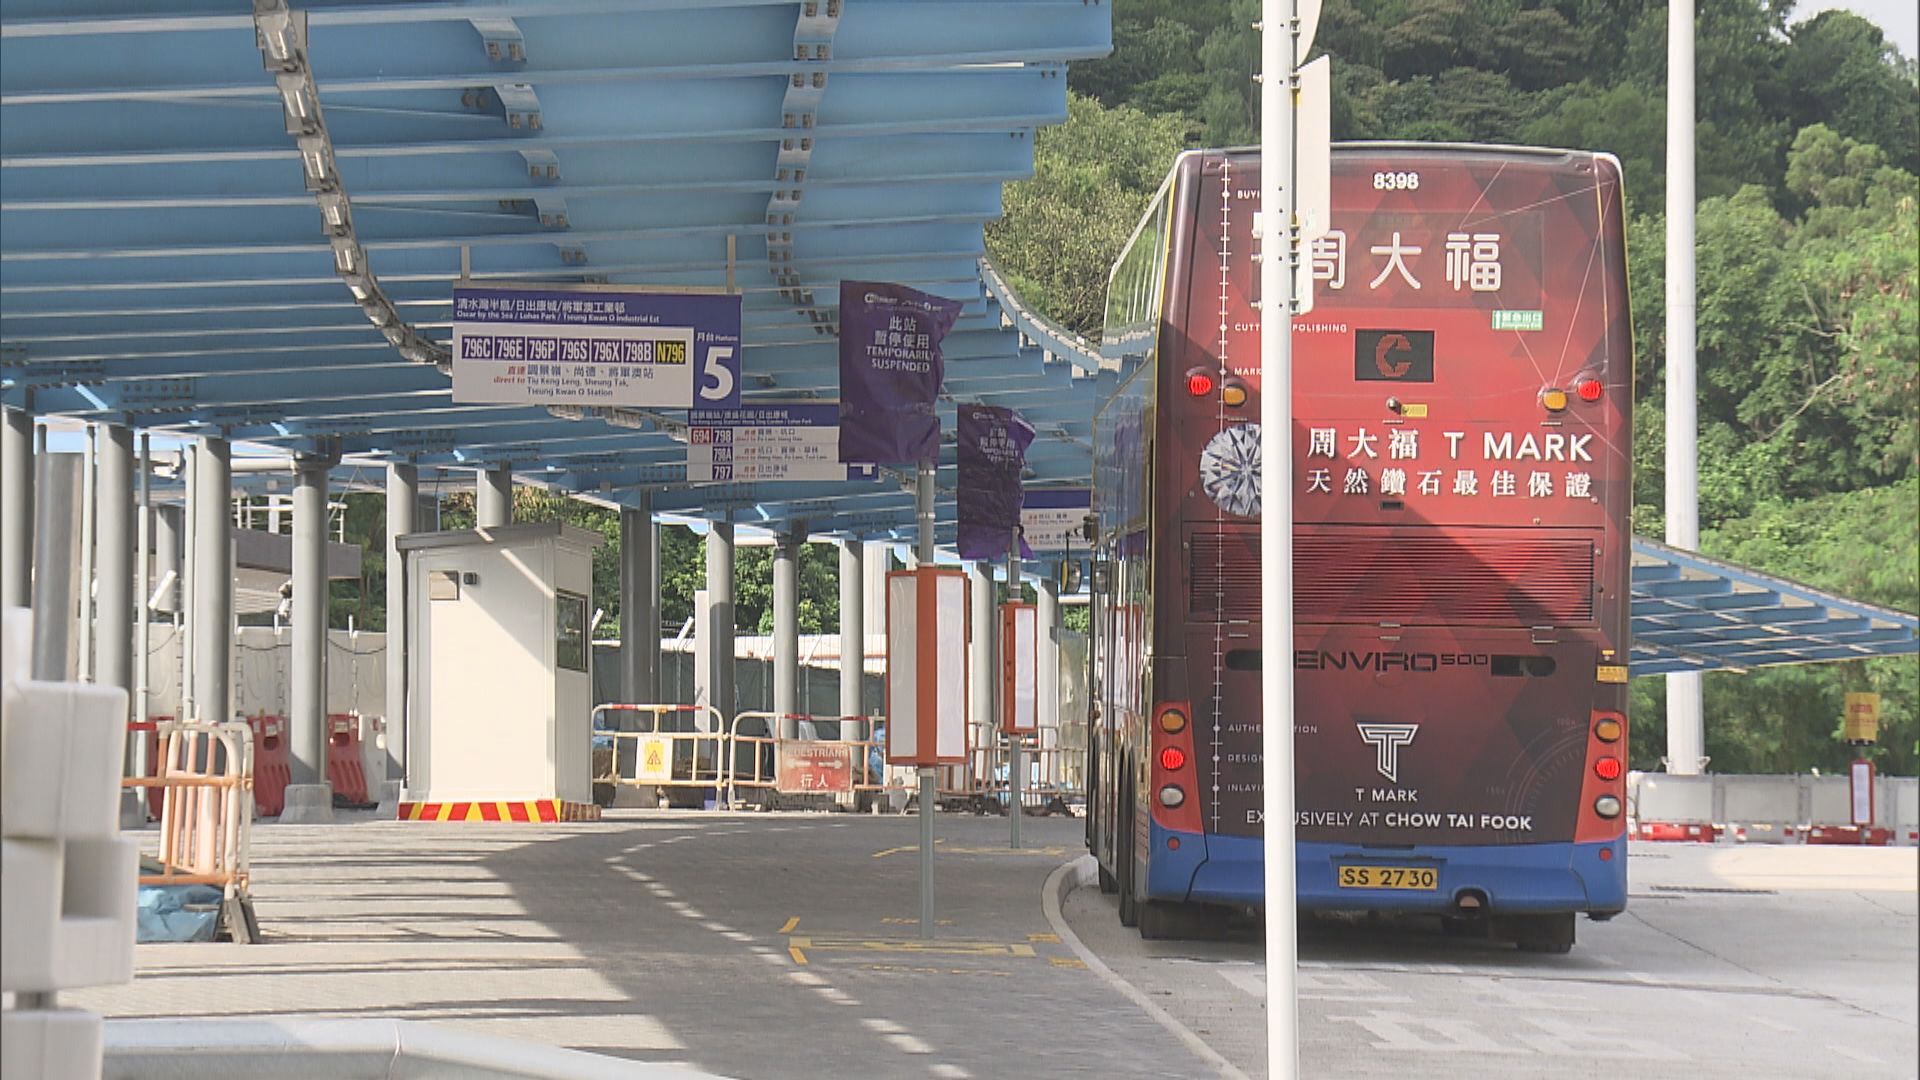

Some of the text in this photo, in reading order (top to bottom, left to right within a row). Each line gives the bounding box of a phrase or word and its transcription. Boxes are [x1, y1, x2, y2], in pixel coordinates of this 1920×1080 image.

[1373, 172, 1419, 190] 8398
[1237, 190, 1261, 199] BUYI
[1312, 230, 1502, 292] 周大福
[541, 313, 557, 321] Park
[888, 315, 917, 332] 此站
[1234, 323, 1261, 332] CUTT
[874, 330, 929, 349] 暫停使用
[464, 338, 685, 362] 796C 796E 796P 796S 796X 798B N796
[866, 345, 935, 361] TEMPORARILY
[699, 345, 734, 401] 5
[871, 358, 930, 373] SUSPENDED
[1234, 367, 1262, 376] MARK
[587, 388, 613, 397] Station
[692, 429, 710, 444] 694
[1307, 427, 1593, 462] 周大福 T MARK
[714, 466, 732, 480] 797
[1306, 468, 1592, 498] 天然鑽石最佳保證
[1294, 650, 1489, 672] ENVIRO 500
[1228, 754, 1264, 763] DESIGN
[800, 773, 829, 788] 行人
[1227, 784, 1264, 792] INLAYI
[1355, 788, 1418, 802] T MARK
[1246, 809, 1533, 831] EXUSIVELY AT CHOW TAI FOOK
[1343, 868, 1434, 887] SS 2730
